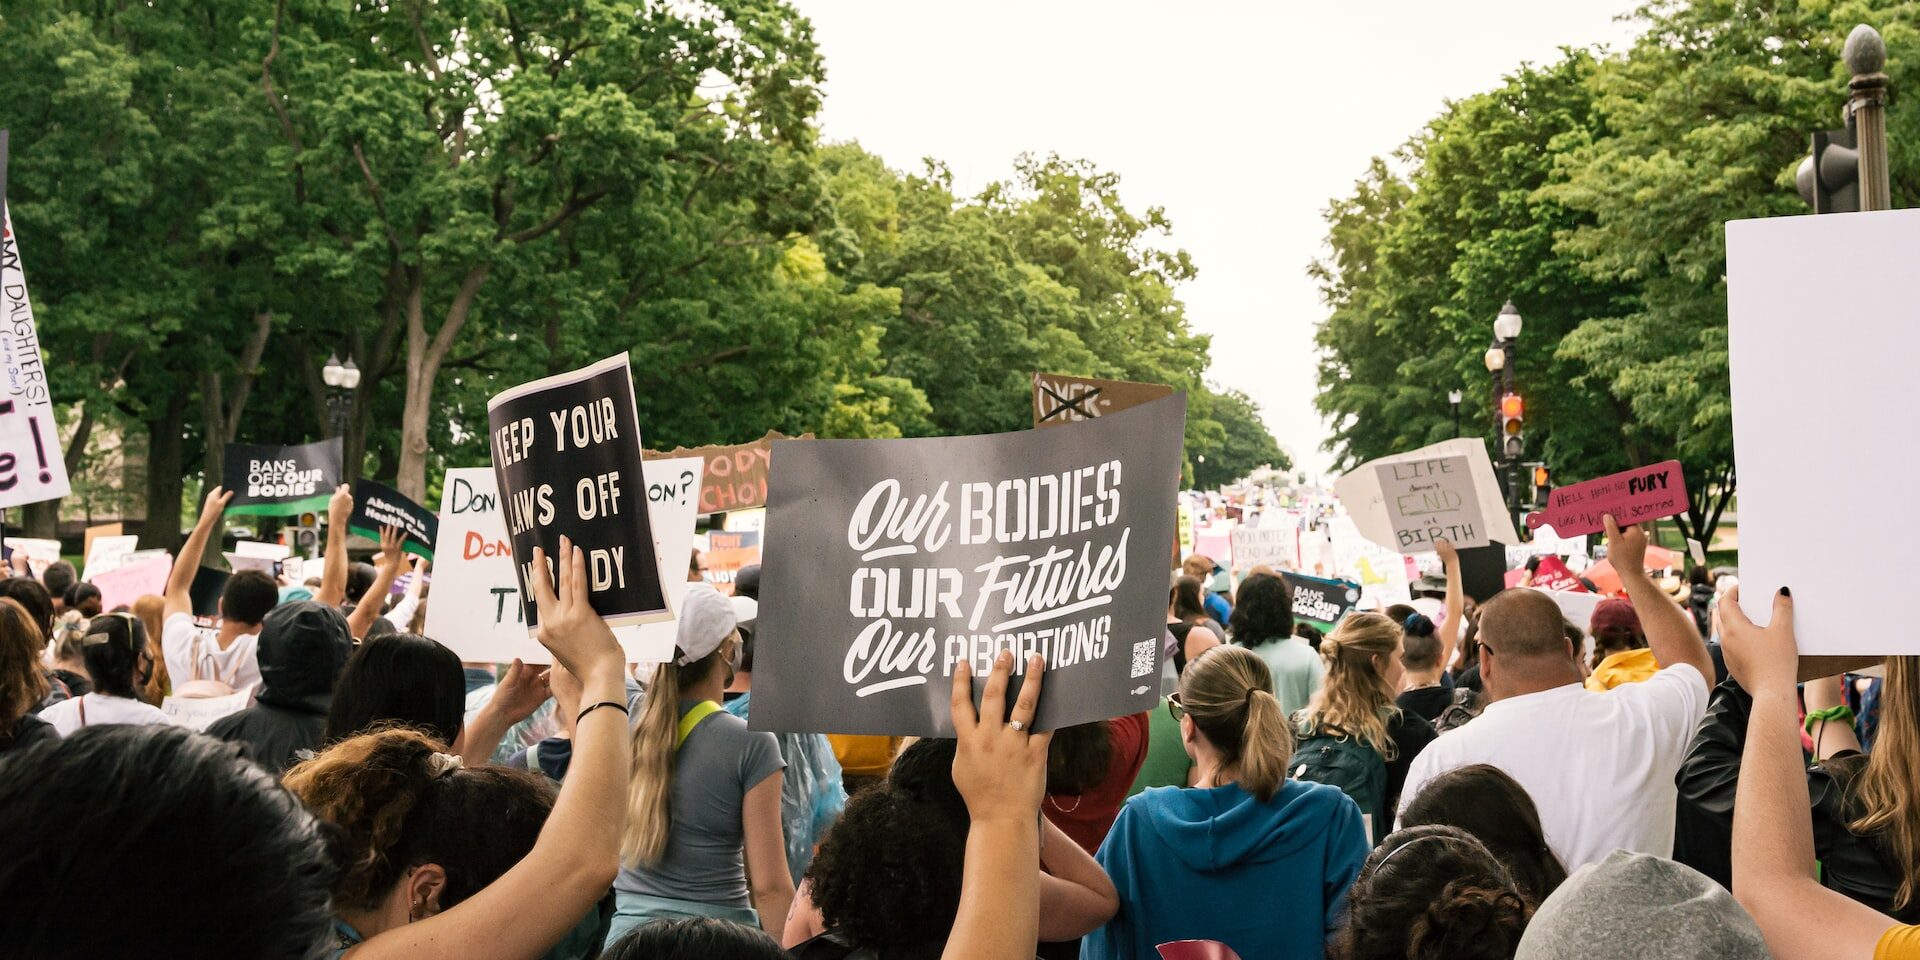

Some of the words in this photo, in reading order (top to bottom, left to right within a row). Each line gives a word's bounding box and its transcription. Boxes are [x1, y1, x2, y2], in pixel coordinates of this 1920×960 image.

[2, 239, 21, 272] MY
[495, 416, 535, 470] KEEP
[550, 396, 619, 451] YOUR
[250, 459, 296, 473] BANS
[704, 448, 771, 477] ODY
[1392, 458, 1454, 481] LIFE
[248, 472, 283, 486] OFF
[283, 468, 323, 484] OUR
[248, 481, 316, 497] BODIES
[1628, 470, 1669, 496] FURY
[366, 496, 416, 525] Abortion
[508, 483, 555, 536] LAWS
[576, 471, 621, 521] OFF
[848, 478, 951, 553] Our
[959, 459, 1122, 545] BODIES
[1397, 489, 1462, 516] END
[365, 506, 405, 529] Health
[1424, 517, 1438, 526] at
[1397, 523, 1476, 547] BIRTH
[850, 567, 963, 619] OUR
[968, 527, 1131, 631] Futures
[1292, 595, 1315, 608] OFF
[1314, 601, 1341, 615] OUR
[1294, 585, 1324, 601] BANS
[1291, 602, 1334, 622] BODIES
[843, 618, 937, 685] Our
[943, 615, 1112, 678] ABORTIONS
